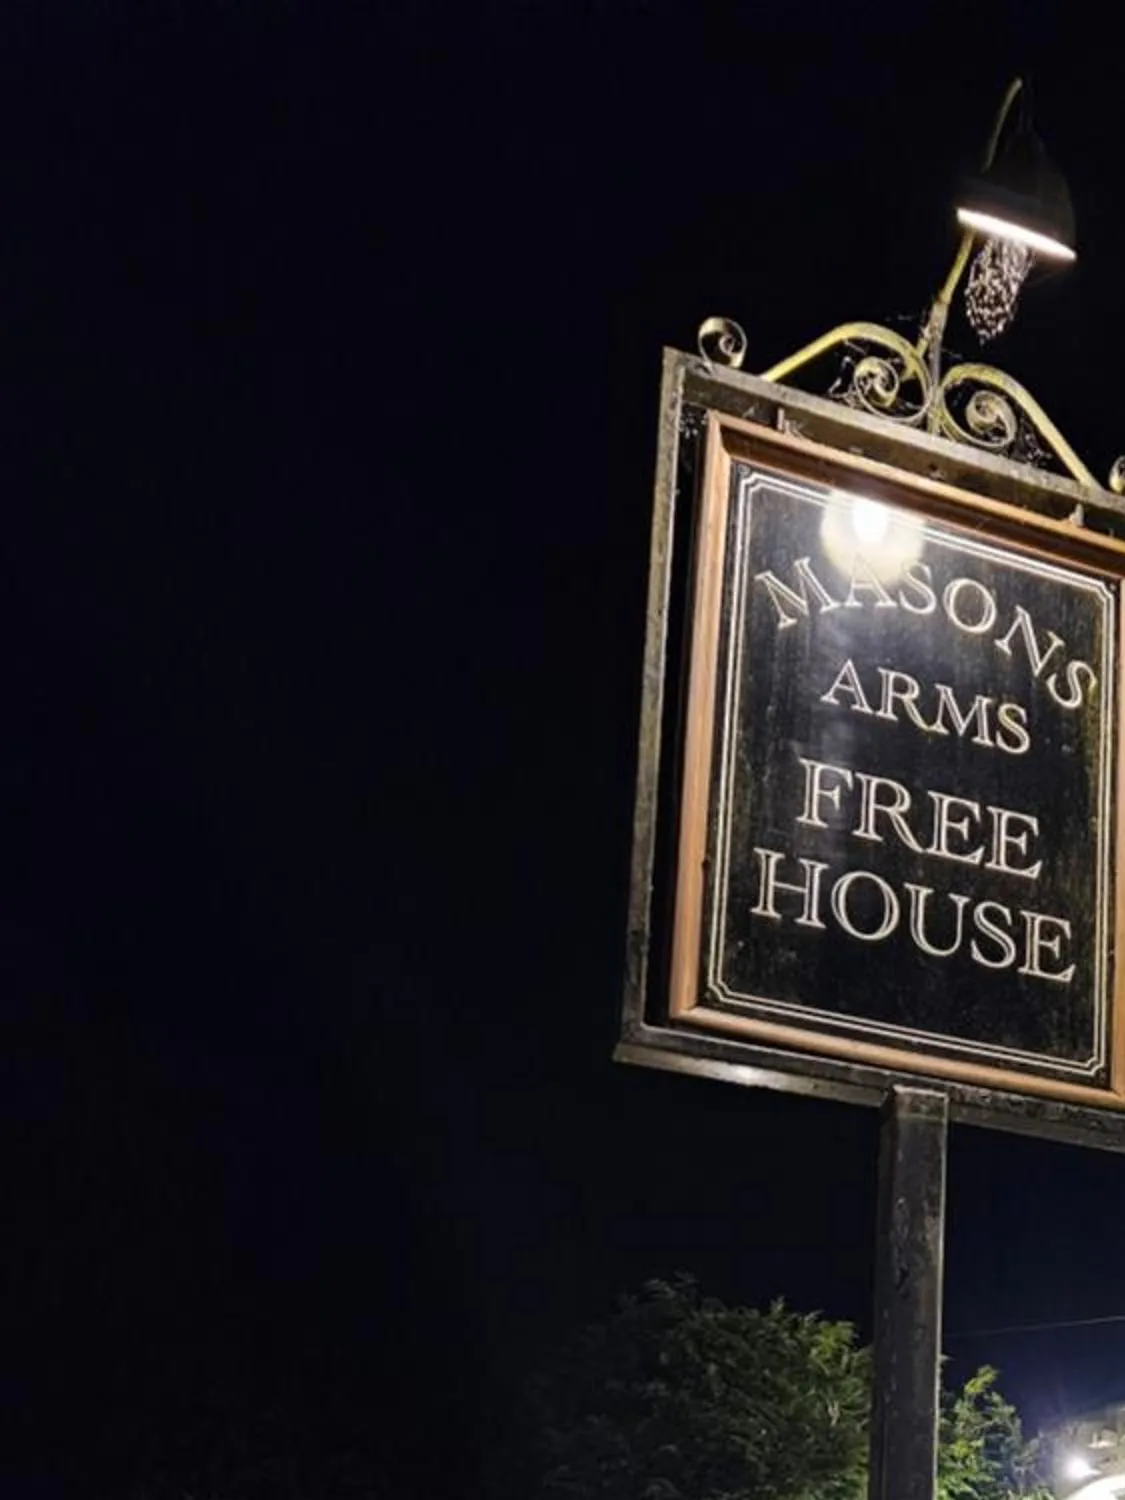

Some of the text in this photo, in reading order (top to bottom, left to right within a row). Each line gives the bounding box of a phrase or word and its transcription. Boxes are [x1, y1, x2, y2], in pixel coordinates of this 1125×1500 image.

[753, 552, 1098, 709] MASONS
[821, 658, 1032, 755] ARMS
[795, 757, 1042, 881] FREE
[750, 847, 1077, 983] HOUSE
